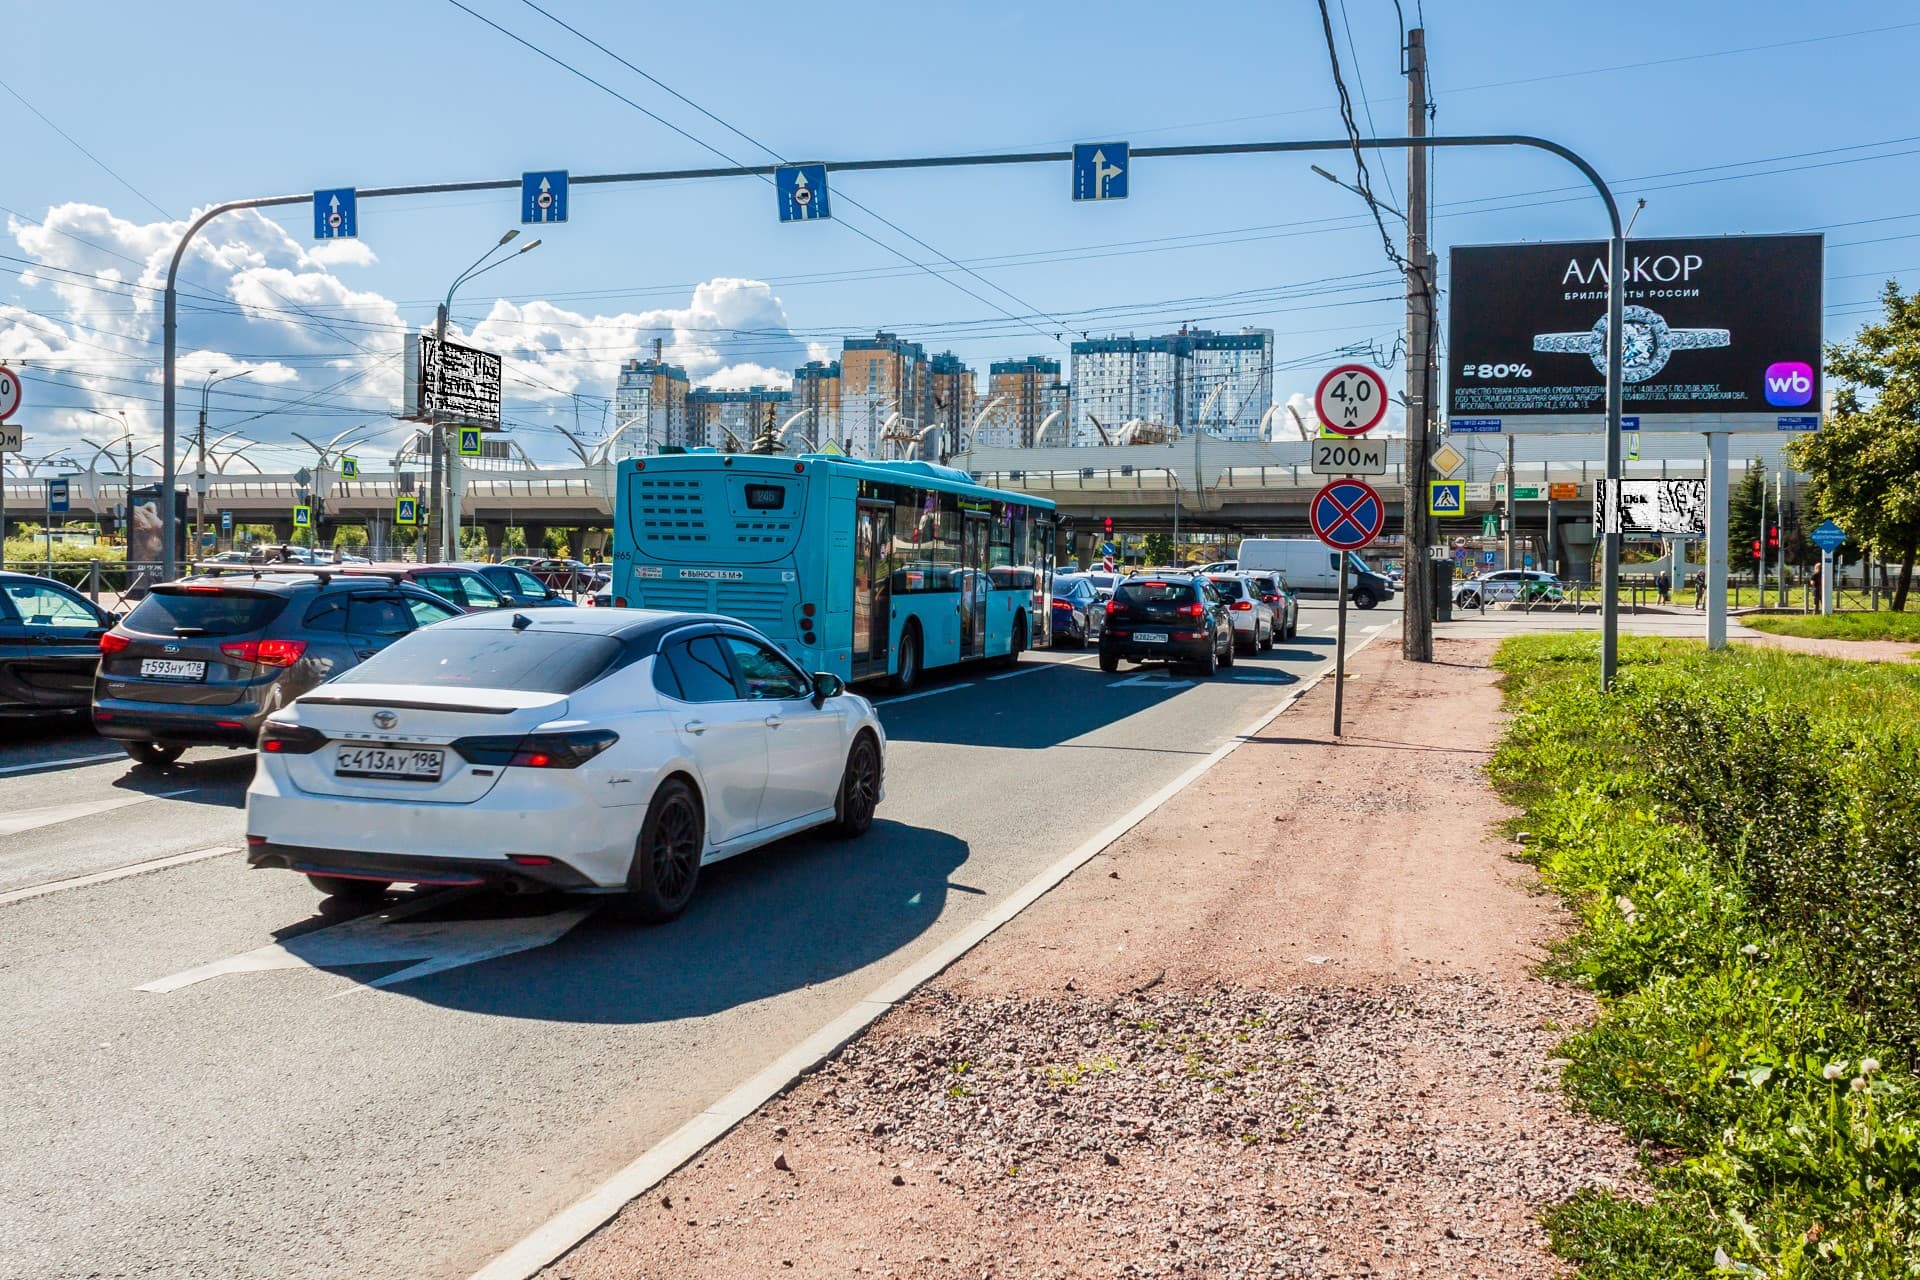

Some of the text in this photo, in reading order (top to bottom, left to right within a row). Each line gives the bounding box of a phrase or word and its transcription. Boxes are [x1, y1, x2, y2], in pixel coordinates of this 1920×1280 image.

[1564, 288, 1700, 301] БРИЛЛИНТЫ РОССИИ
[1477, 363, 1533, 379] 80%
[1768, 370, 1810, 393] wb
[1330, 380, 1371, 404] 4,0
[687, 570, 715, 579] ВЫНОС
[187, 663, 202, 671] 178
[412, 753, 440, 767] 198
